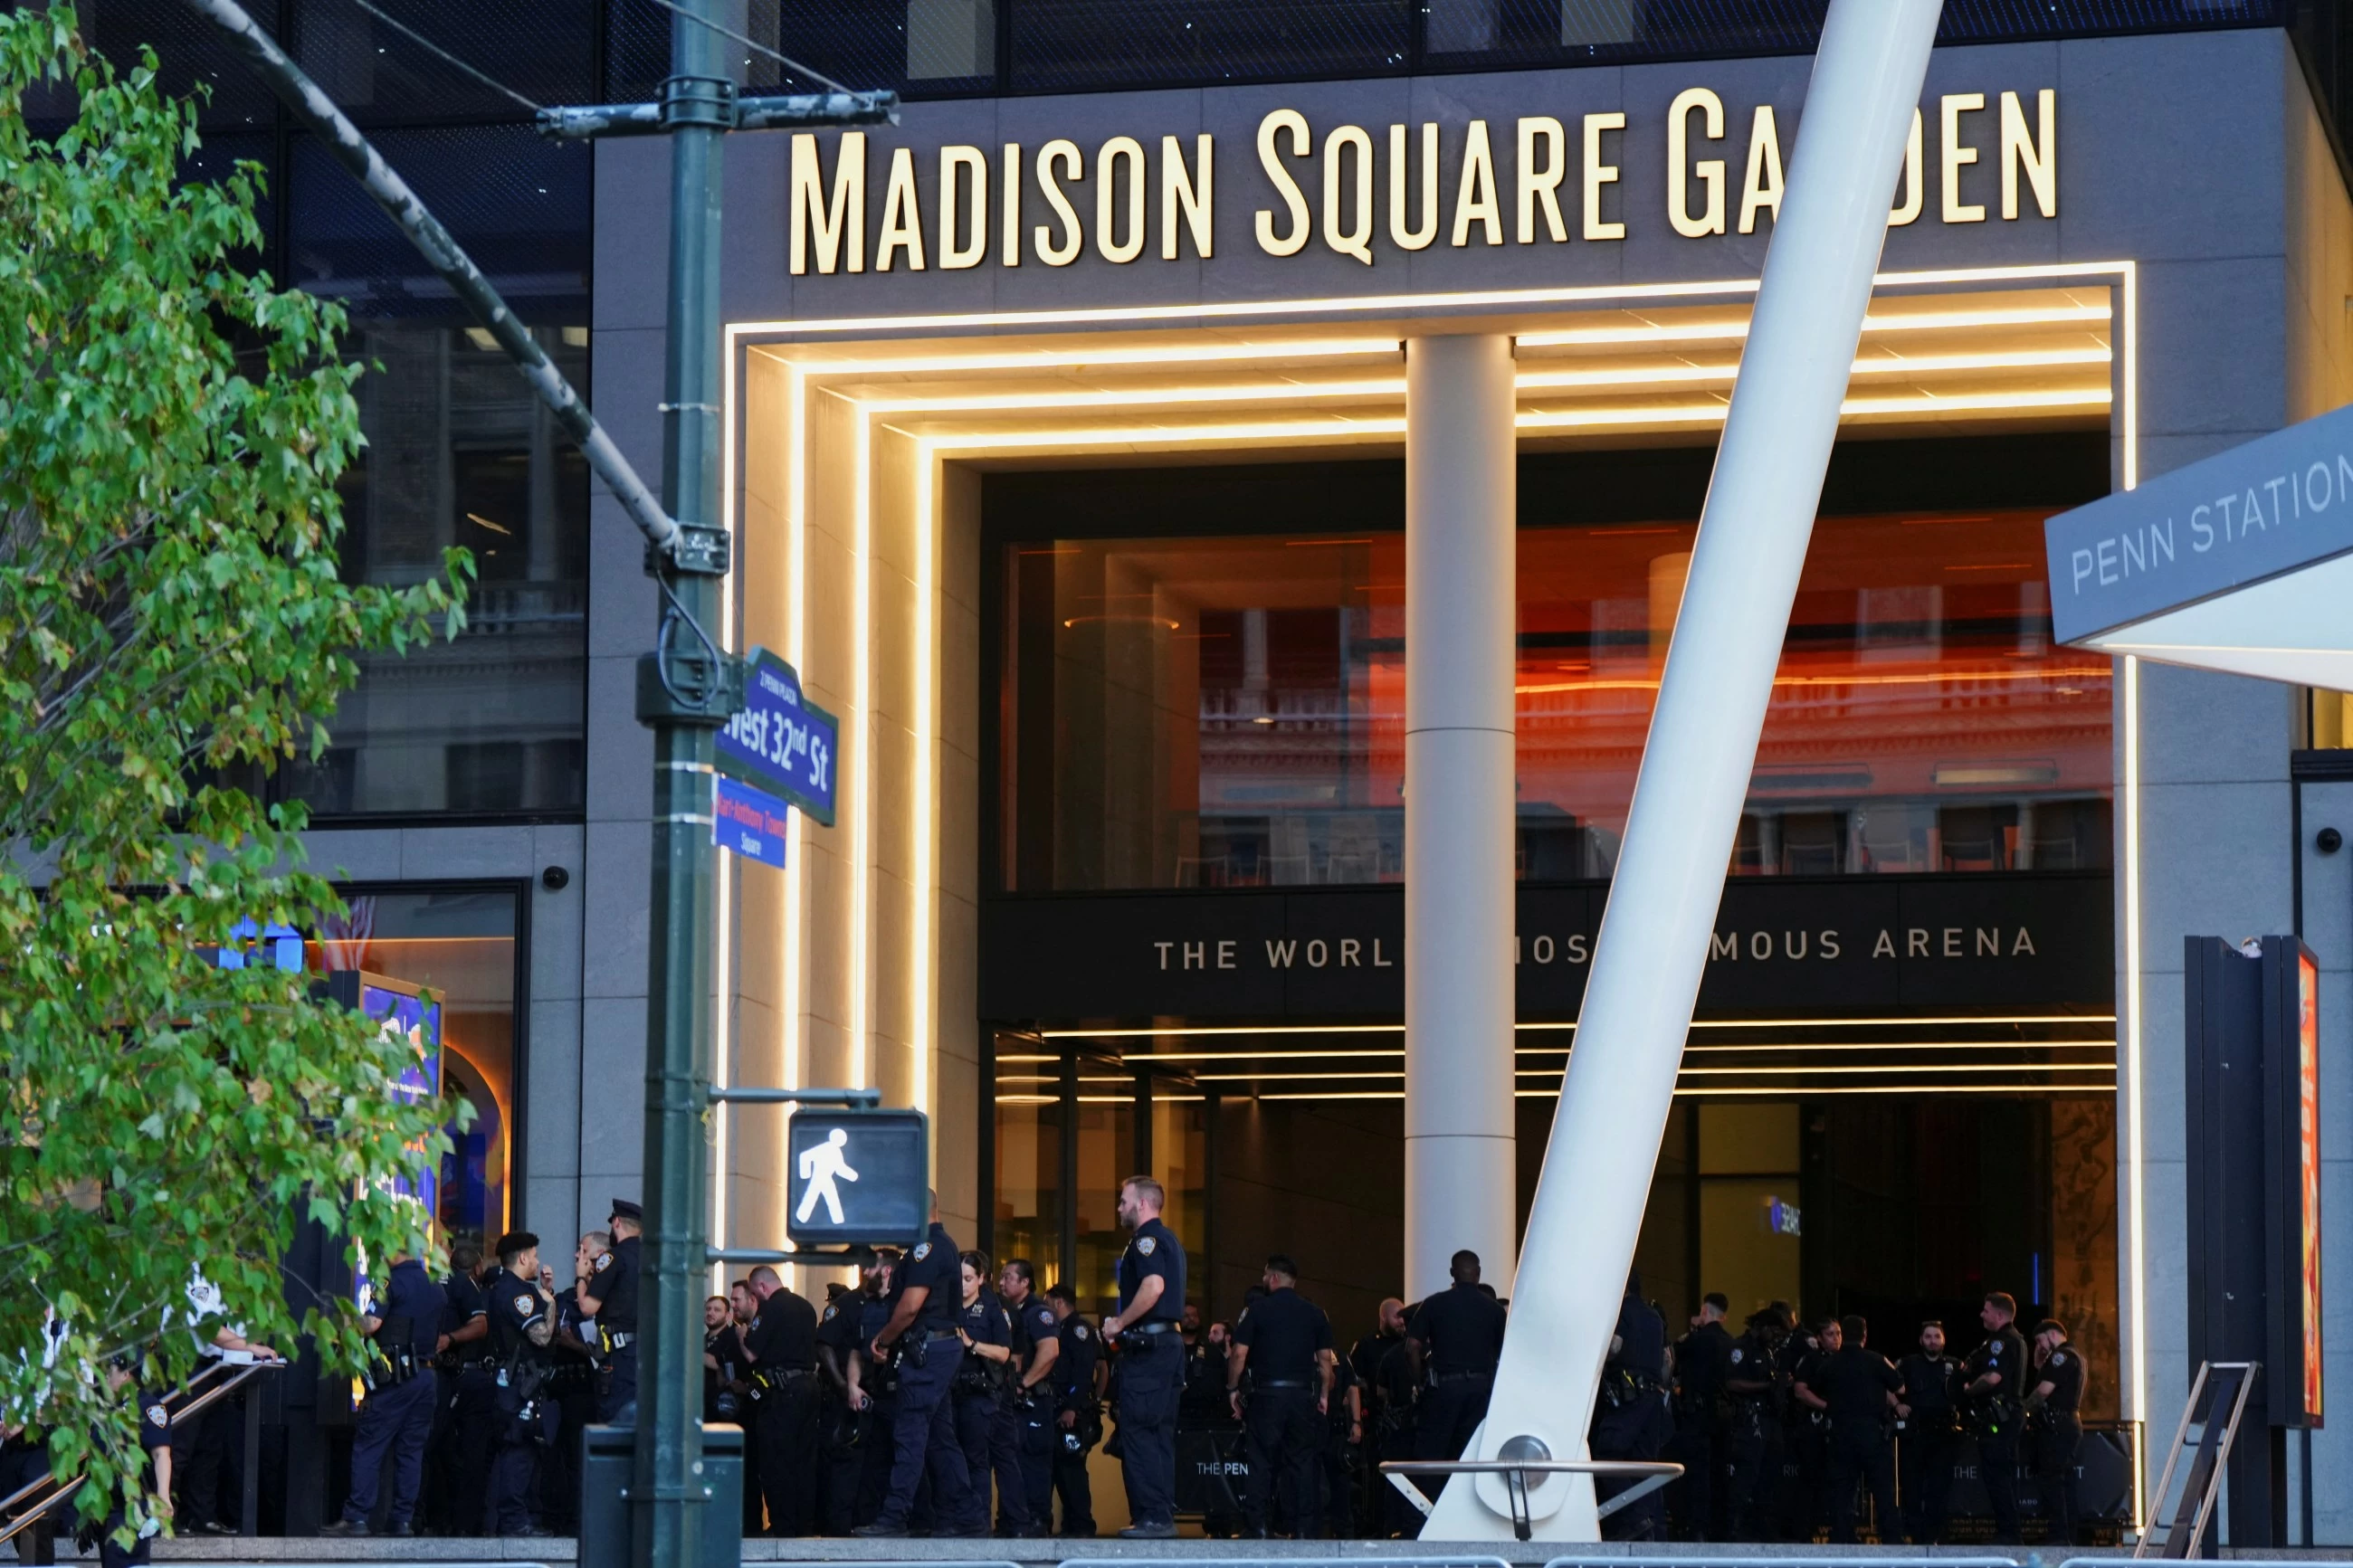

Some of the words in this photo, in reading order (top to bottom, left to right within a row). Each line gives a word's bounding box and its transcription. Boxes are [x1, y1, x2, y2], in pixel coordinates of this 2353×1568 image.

[789, 131, 1213, 275] MADISON
[1255, 109, 1626, 266] SQUARE
[1667, 88, 2056, 237] GAEN
[2072, 518, 2175, 595] PENN
[2190, 453, 2353, 553] STATION
[771, 711, 807, 772] 32nd
[809, 735, 828, 792] St
[741, 831, 762, 856] Square
[1154, 940, 1237, 970] THE
[1265, 938, 1393, 968] WORL
[1515, 934, 1587, 965] OS
[1710, 930, 1841, 961] MOUS
[1872, 927, 2036, 958] ARENA
[1196, 1462, 1220, 1476] THE
[1224, 1462, 1249, 1476] PEN
